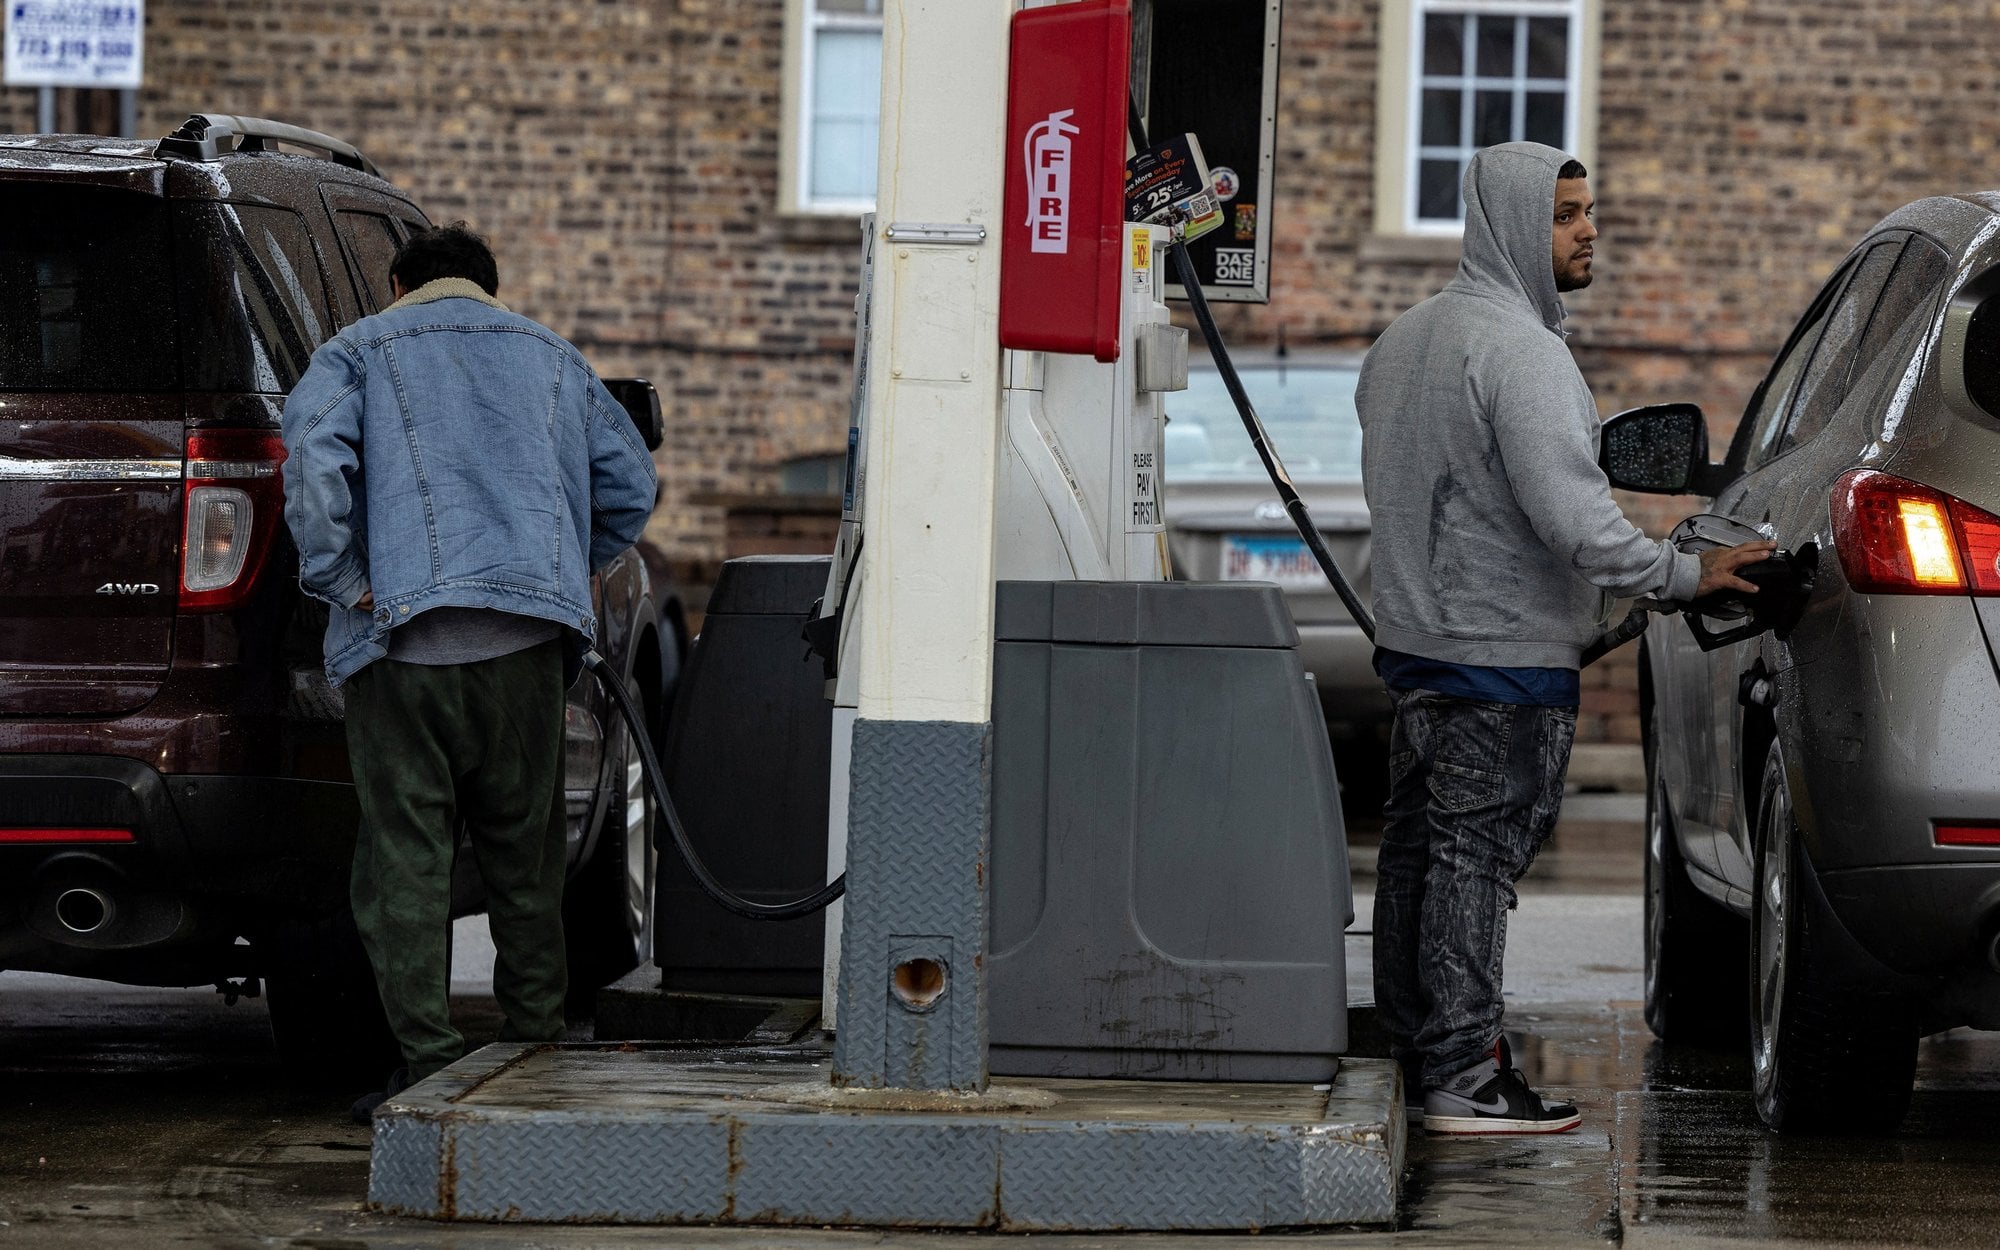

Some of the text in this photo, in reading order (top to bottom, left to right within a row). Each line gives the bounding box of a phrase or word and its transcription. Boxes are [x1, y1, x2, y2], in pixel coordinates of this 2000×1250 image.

[1135, 173, 1153, 185] More
[1153, 167, 1164, 175] on
[1165, 158, 1185, 168] Every
[1145, 168, 1180, 186] Gameday
[1038, 149, 1064, 240] FIRE
[1216, 253, 1253, 266] DAS
[1216, 267, 1253, 280] ONE
[1133, 453, 1153, 468] PLEASE
[1136, 473, 1150, 497] PAY
[1133, 502, 1154, 526] FIRST
[95, 582, 160, 596] 4WD
